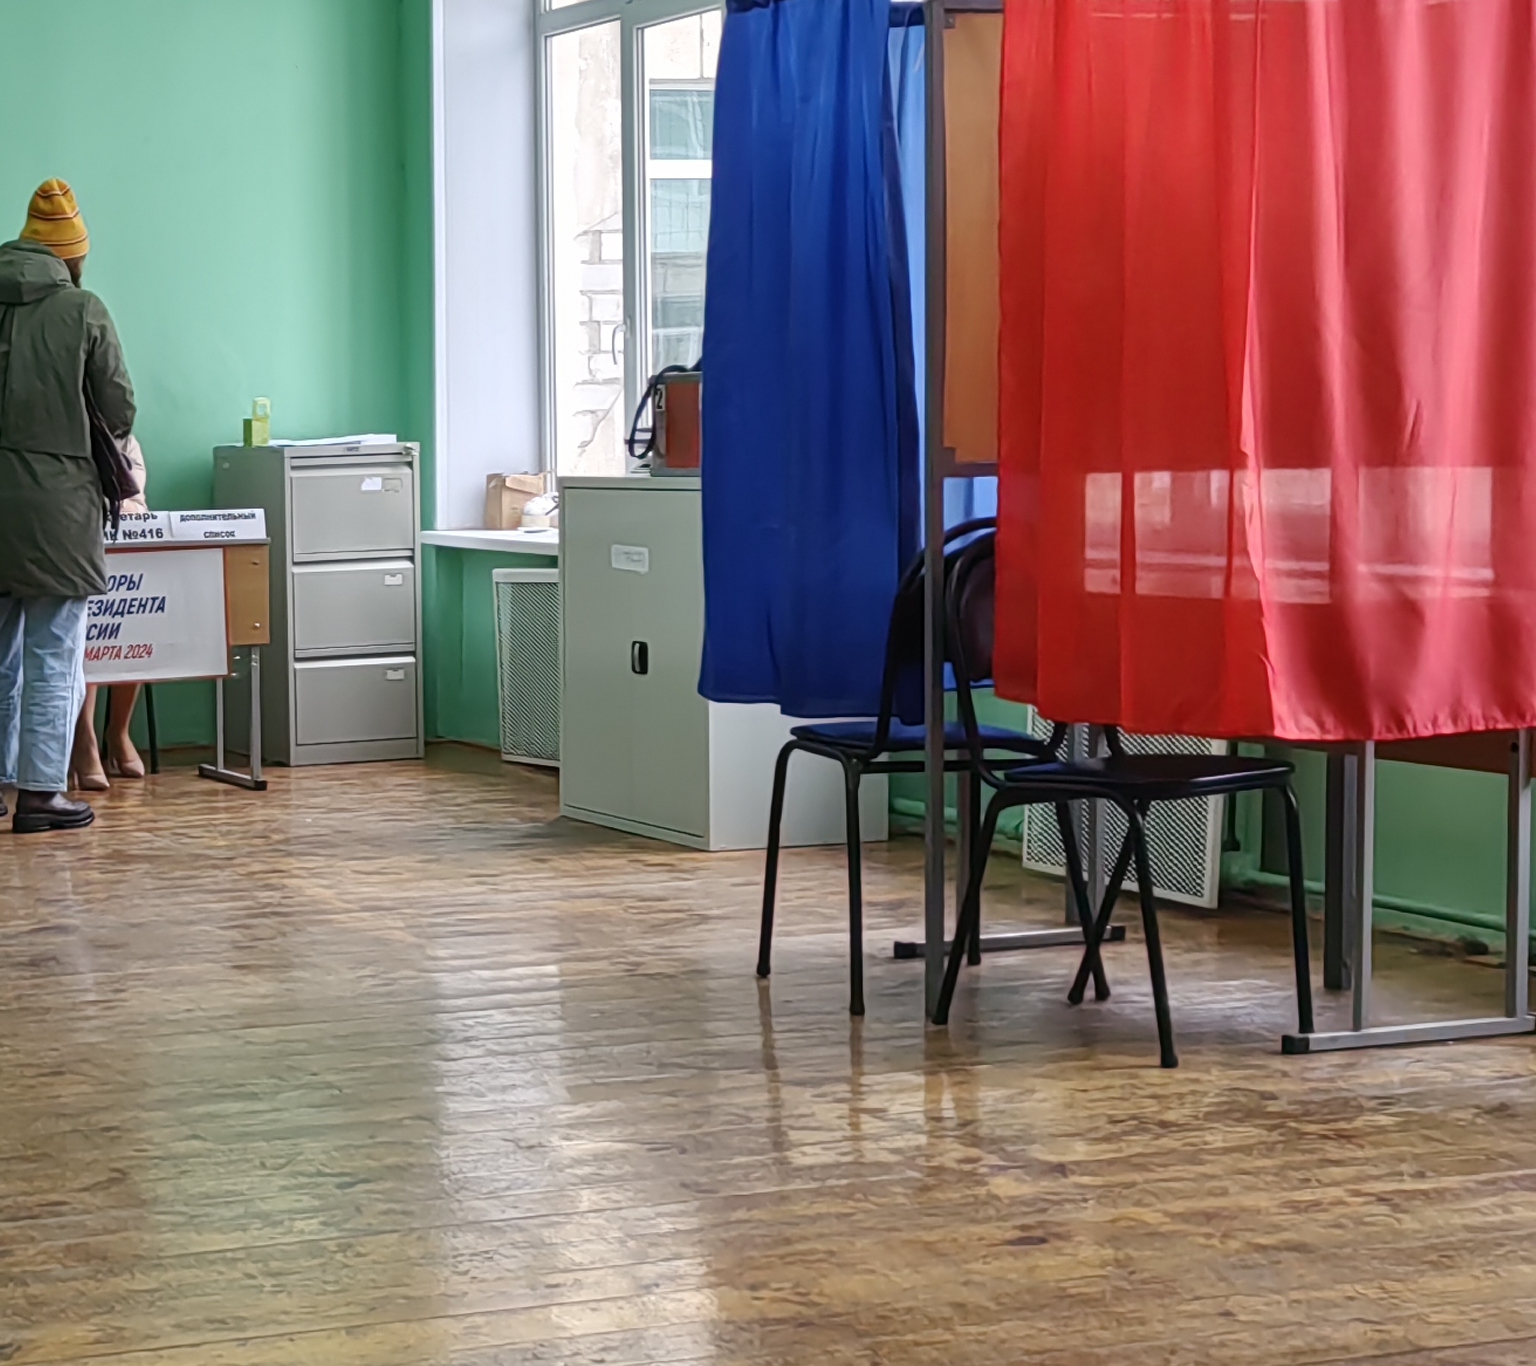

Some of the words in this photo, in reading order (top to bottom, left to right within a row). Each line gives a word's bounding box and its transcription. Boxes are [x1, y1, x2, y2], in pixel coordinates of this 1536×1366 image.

[123, 527, 164, 540] №416
[106, 573, 144, 593] ОРЫ
[86, 595, 166, 619] ЕЗИДЕНТА
[85, 622, 122, 642] СИИ
[123, 642, 154, 660] 2024
